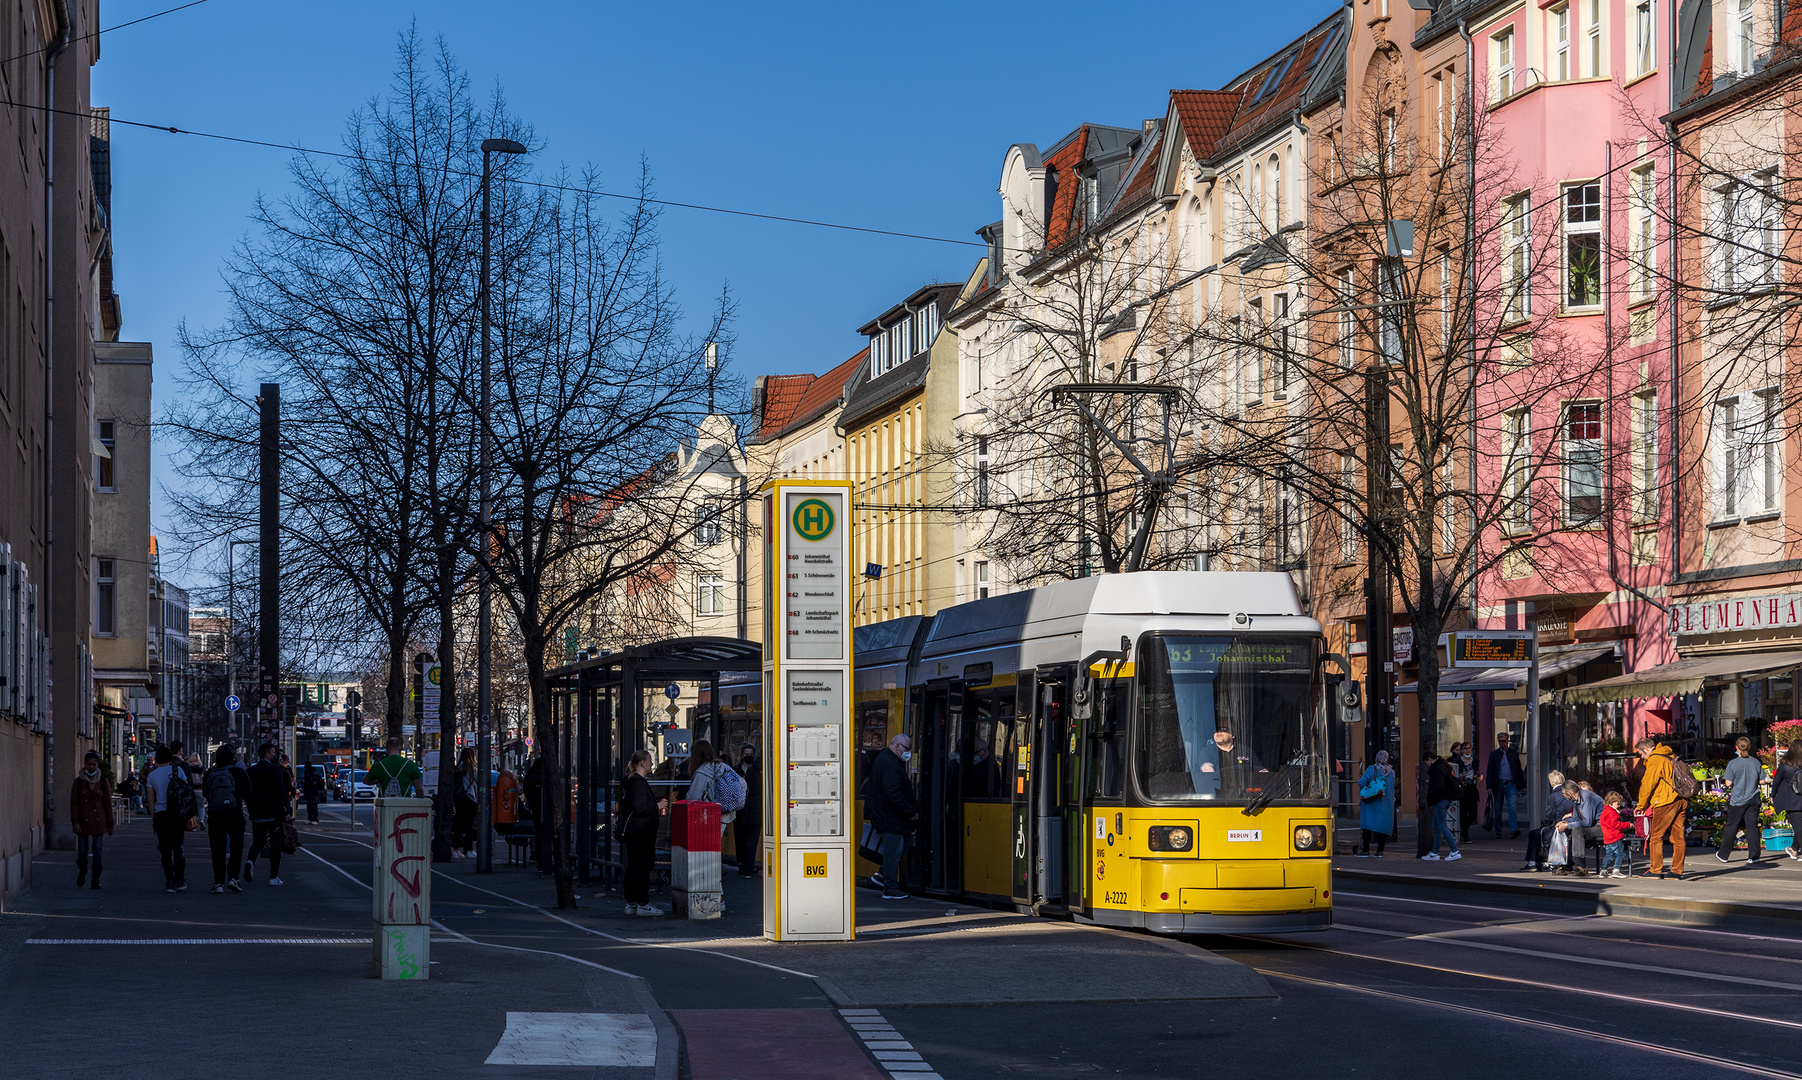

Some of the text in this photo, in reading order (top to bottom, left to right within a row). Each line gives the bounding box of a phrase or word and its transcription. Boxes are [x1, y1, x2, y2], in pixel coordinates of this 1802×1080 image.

[804, 508, 823, 532] H
[869, 564, 880, 576] W
[1671, 597, 1797, 633] BLUMENHA
[1199, 643, 1293, 654] Landschaftspark
[1210, 653, 1286, 663] Johannisthal
[1096, 849, 1105, 858] BVG
[806, 865, 825, 876] BVG
[1104, 891, 1128, 905] A-2222
